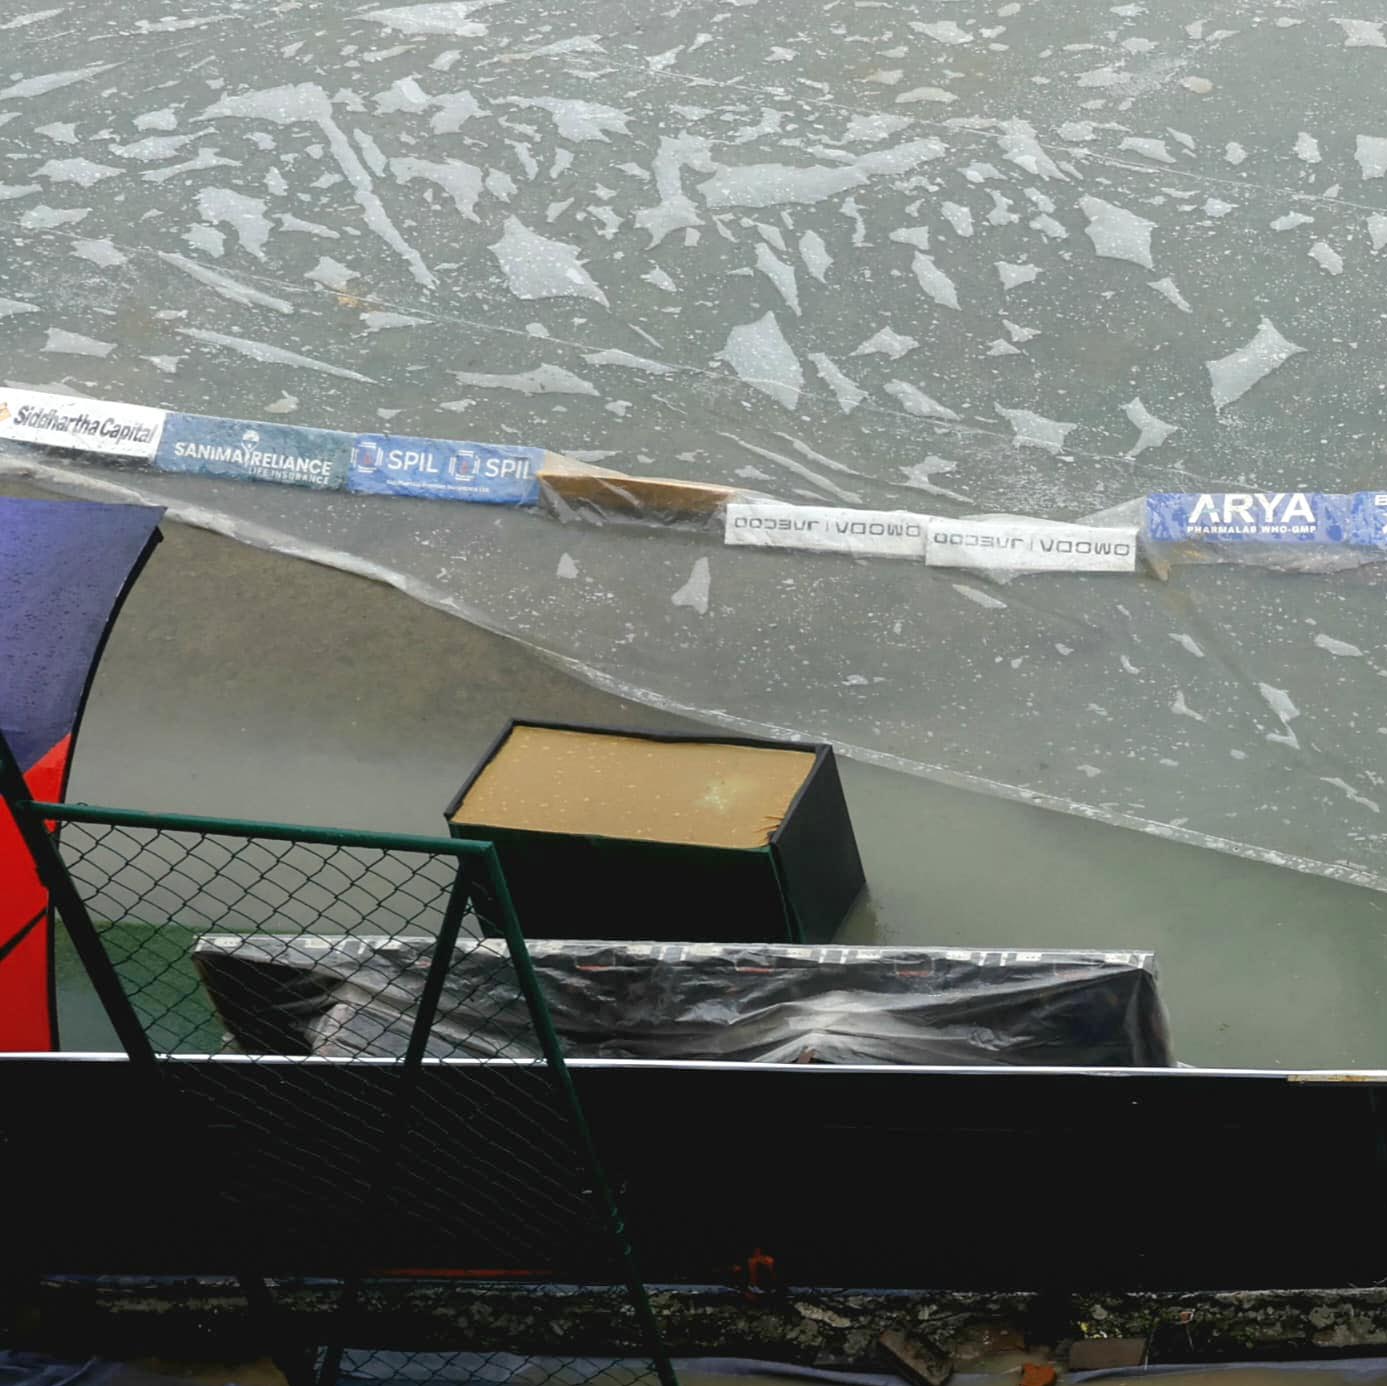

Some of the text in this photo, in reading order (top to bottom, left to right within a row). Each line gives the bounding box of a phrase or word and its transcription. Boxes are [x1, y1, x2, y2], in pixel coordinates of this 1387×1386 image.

[100, 417, 159, 445] Capital
[174, 442, 333, 476] SANIMA RELIANCE
[387, 450, 535, 480] SPIL SPIL
[1187, 493, 1317, 524] ARYA
[836, 521, 921, 537] OMODA
[1186, 525, 1317, 534] PHARMALAB WHO-GMP
[1039, 539, 1130, 556] OMODA
